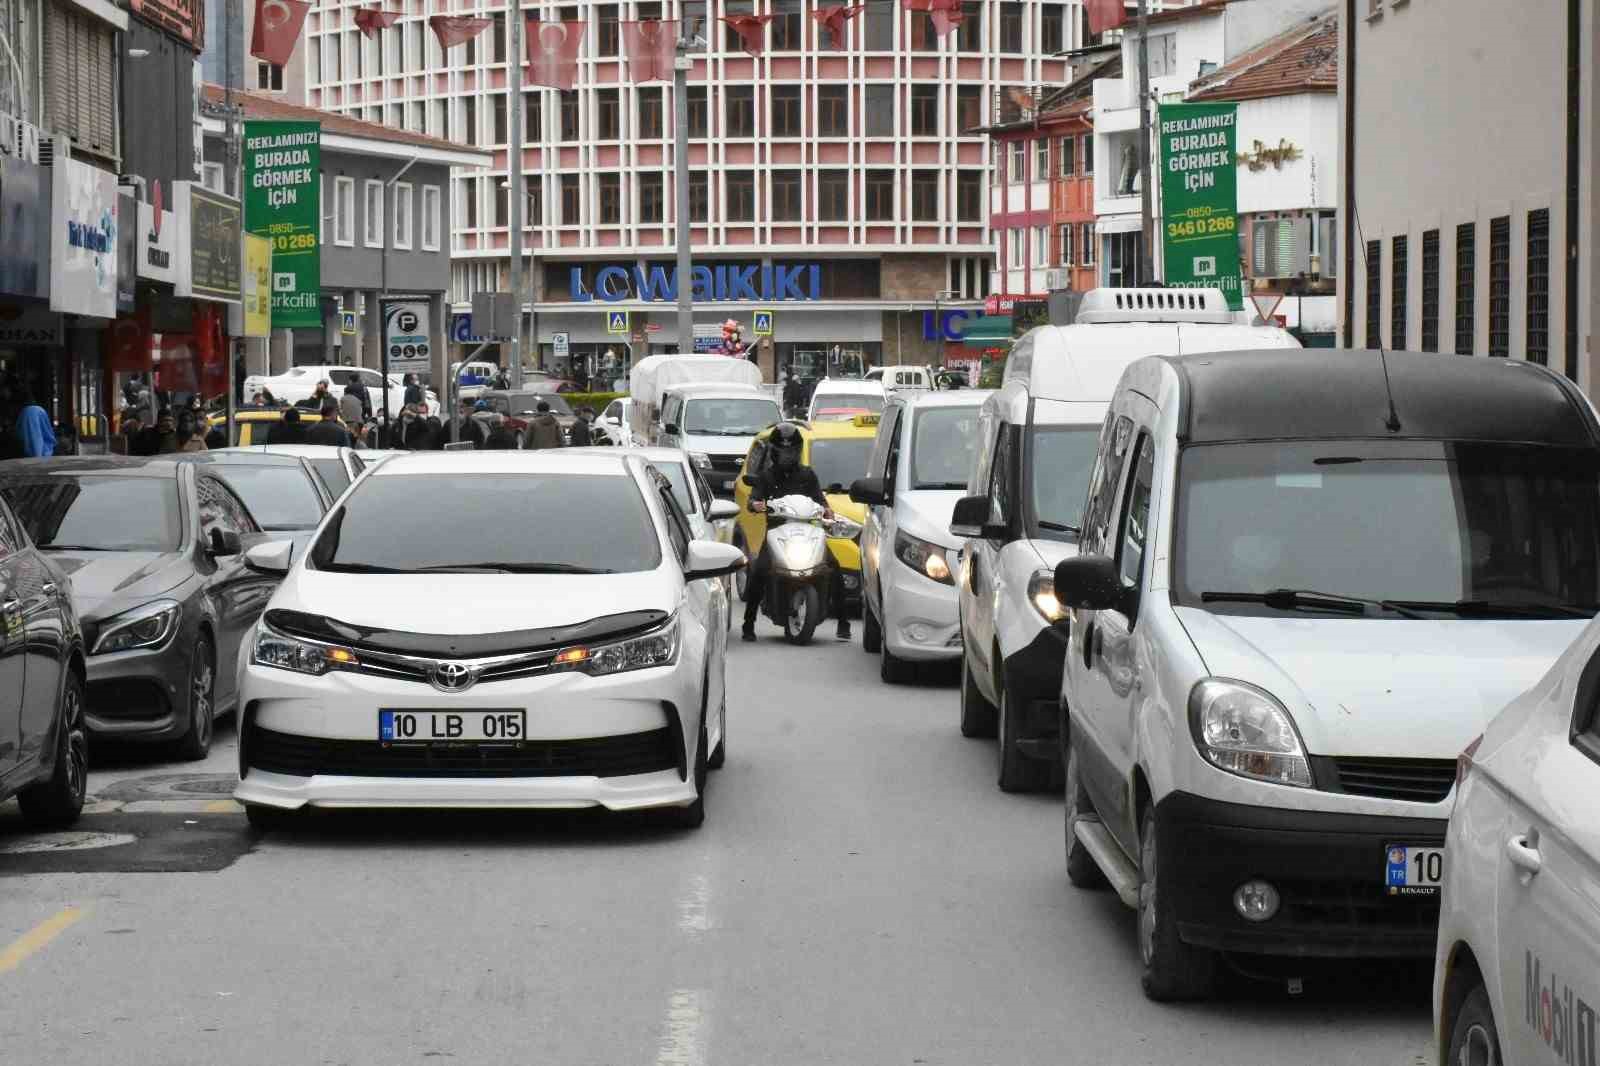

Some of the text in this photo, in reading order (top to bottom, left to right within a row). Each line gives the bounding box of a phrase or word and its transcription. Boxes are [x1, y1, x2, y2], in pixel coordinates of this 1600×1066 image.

[1162, 112, 1234, 134] REKLAMINIZI
[247, 131, 318, 150] REKLAMINIZI
[1170, 131, 1227, 153] BURADA
[255, 149, 310, 168] BURADA
[1169, 150, 1229, 172] GÖRMEK
[253, 168, 312, 188] GÖRMEK
[1184, 170, 1215, 193] İÇİN
[268, 186, 297, 210] İÇİN
[1186, 206, 1212, 219] 0850
[269, 223, 294, 234] 0850
[394, 714, 417, 738] 10
[431, 714, 463, 738] LB
[482, 714, 521, 738] 015
[1391, 852, 1442, 883] TR 10
